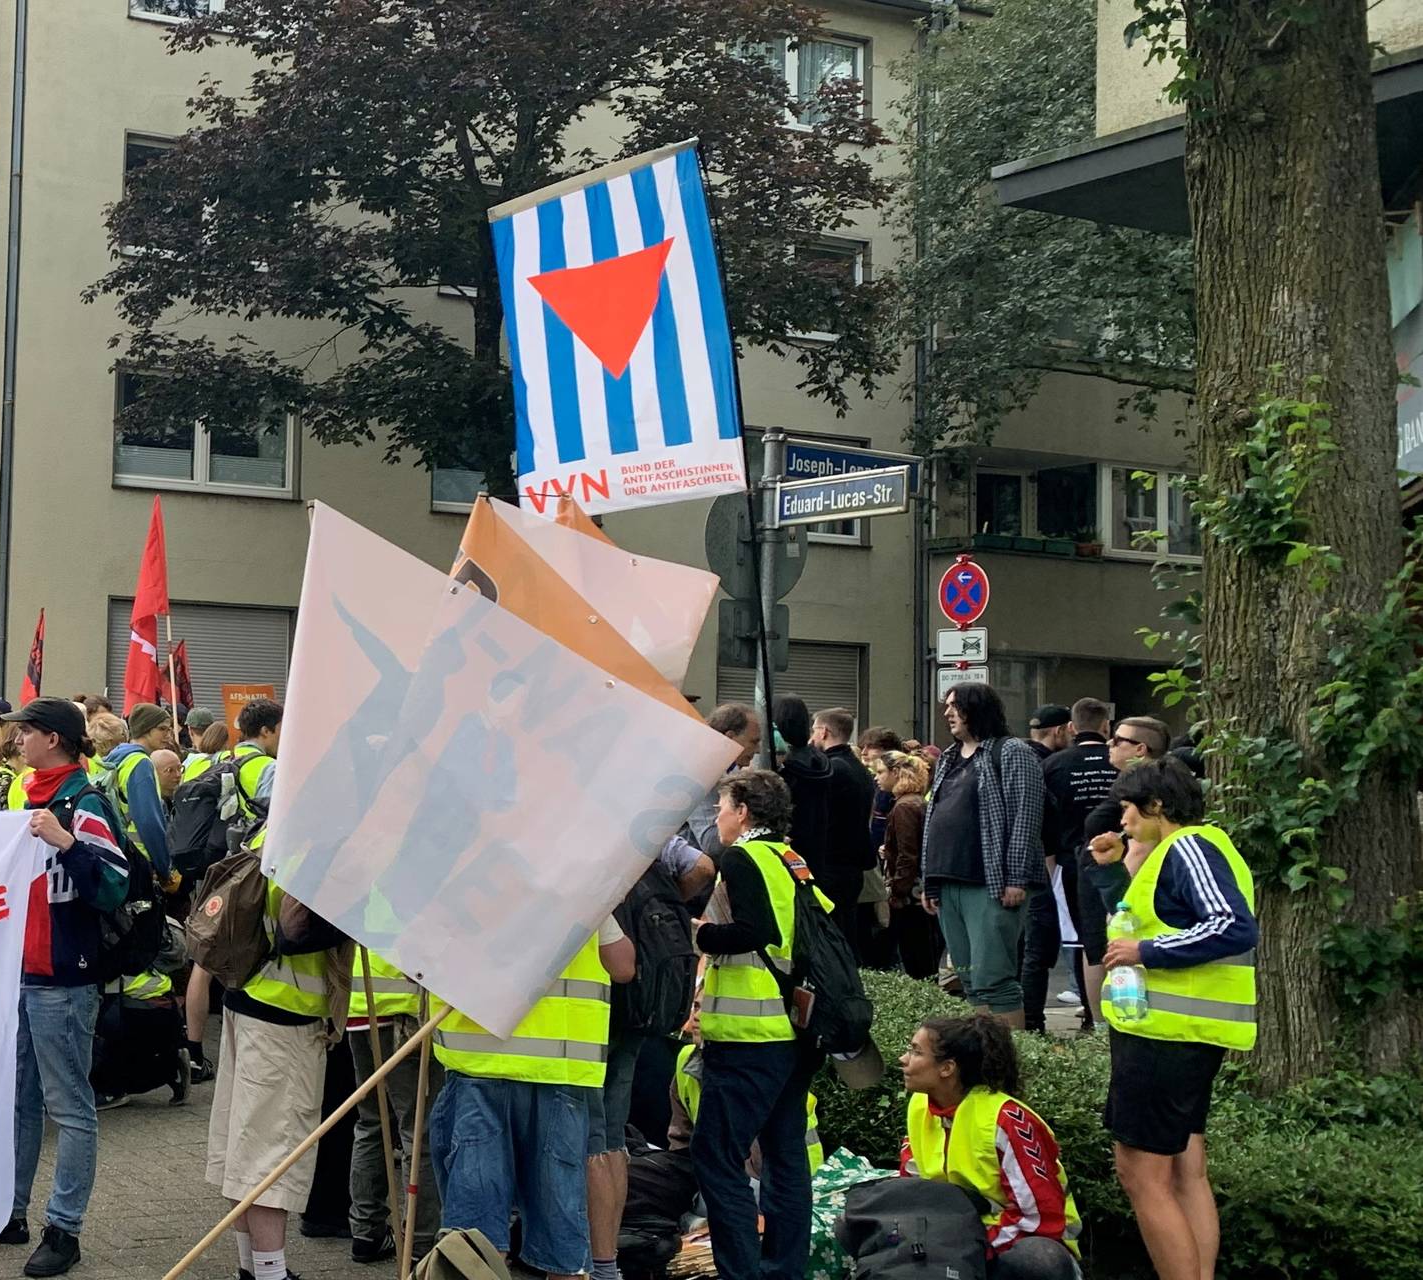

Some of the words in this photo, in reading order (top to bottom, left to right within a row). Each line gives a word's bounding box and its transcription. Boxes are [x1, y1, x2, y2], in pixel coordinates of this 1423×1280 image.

[621, 463, 651, 475] BUND
[654, 459, 675, 471] DER
[622, 463, 734, 485] ANTIFASCHISTINNEN
[524, 469, 610, 514] VVN
[624, 485, 647, 496] UND
[650, 473, 741, 492] ANTIFASCHISTEN
[783, 483, 896, 516] Eduard-Lucas-Str.
